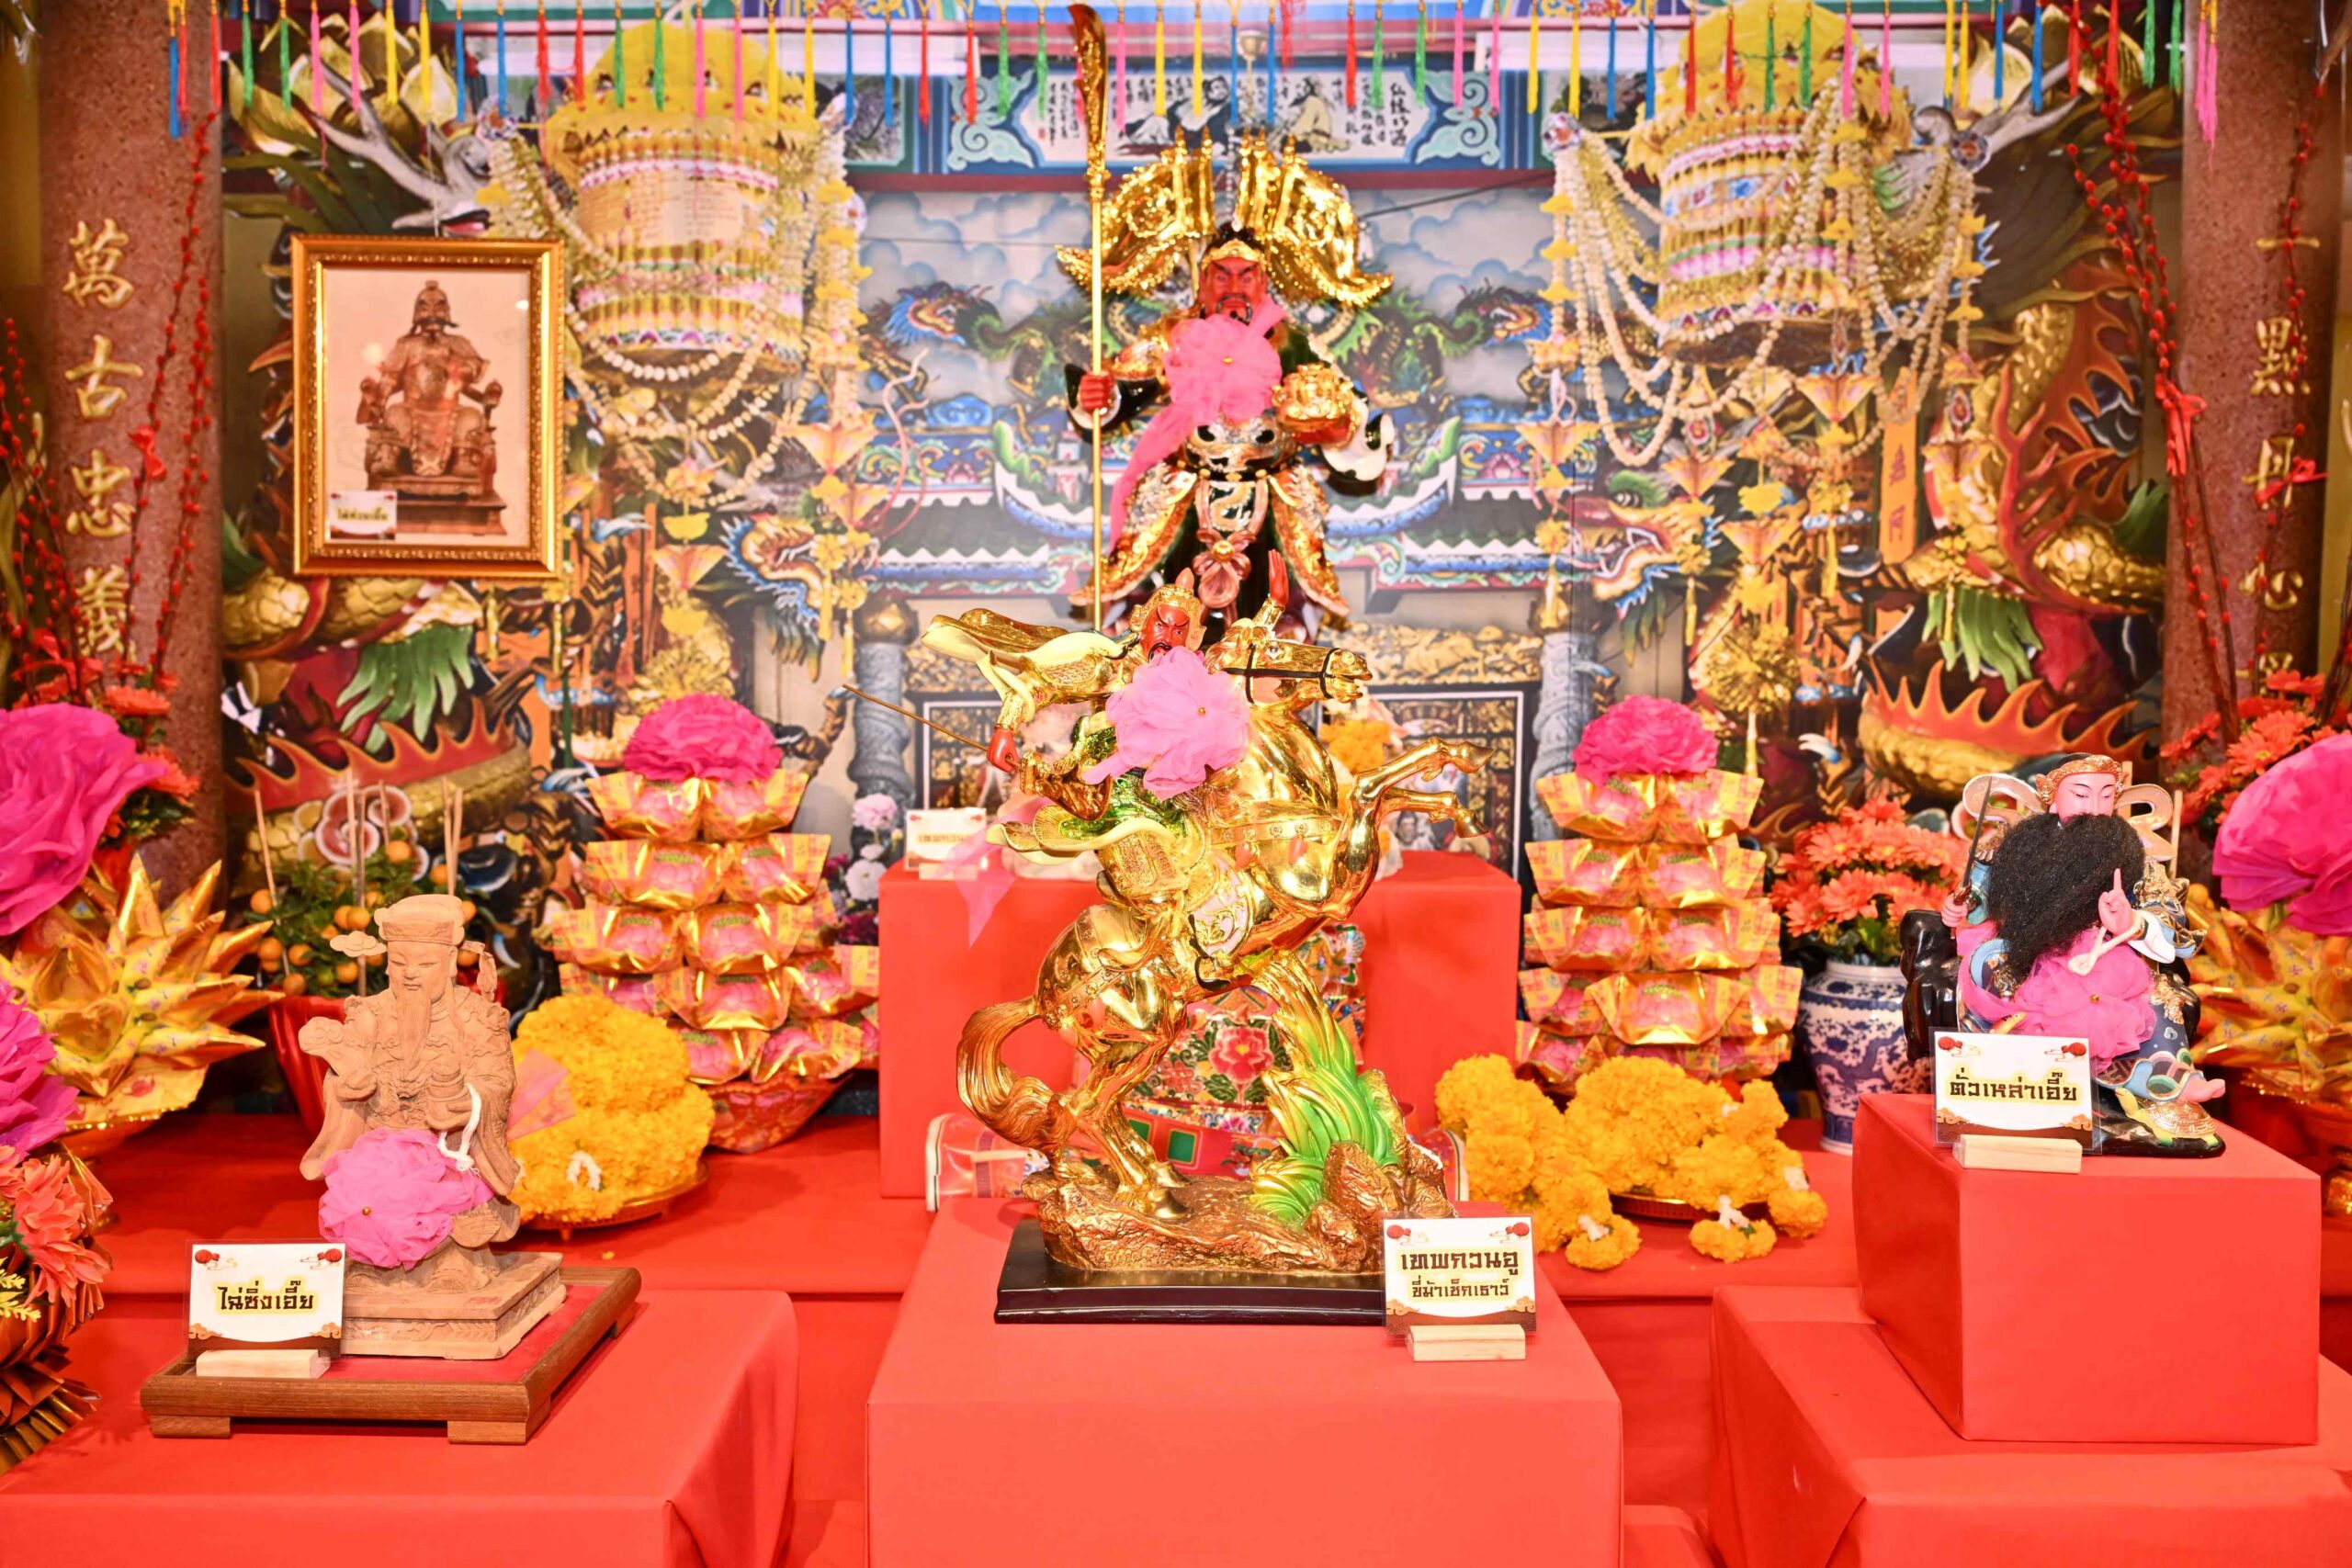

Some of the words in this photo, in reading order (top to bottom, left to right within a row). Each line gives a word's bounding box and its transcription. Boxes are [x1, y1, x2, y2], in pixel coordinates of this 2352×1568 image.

[62, 218, 143, 661] 萬古忠義
[1950, 1067, 2077, 1100] ตั่วเหล่าเอี๊ย
[1400, 1251, 1519, 1275] เทพกวนอู
[217, 1280, 314, 1310] ไฉ่ซิ่งเอี๊ย
